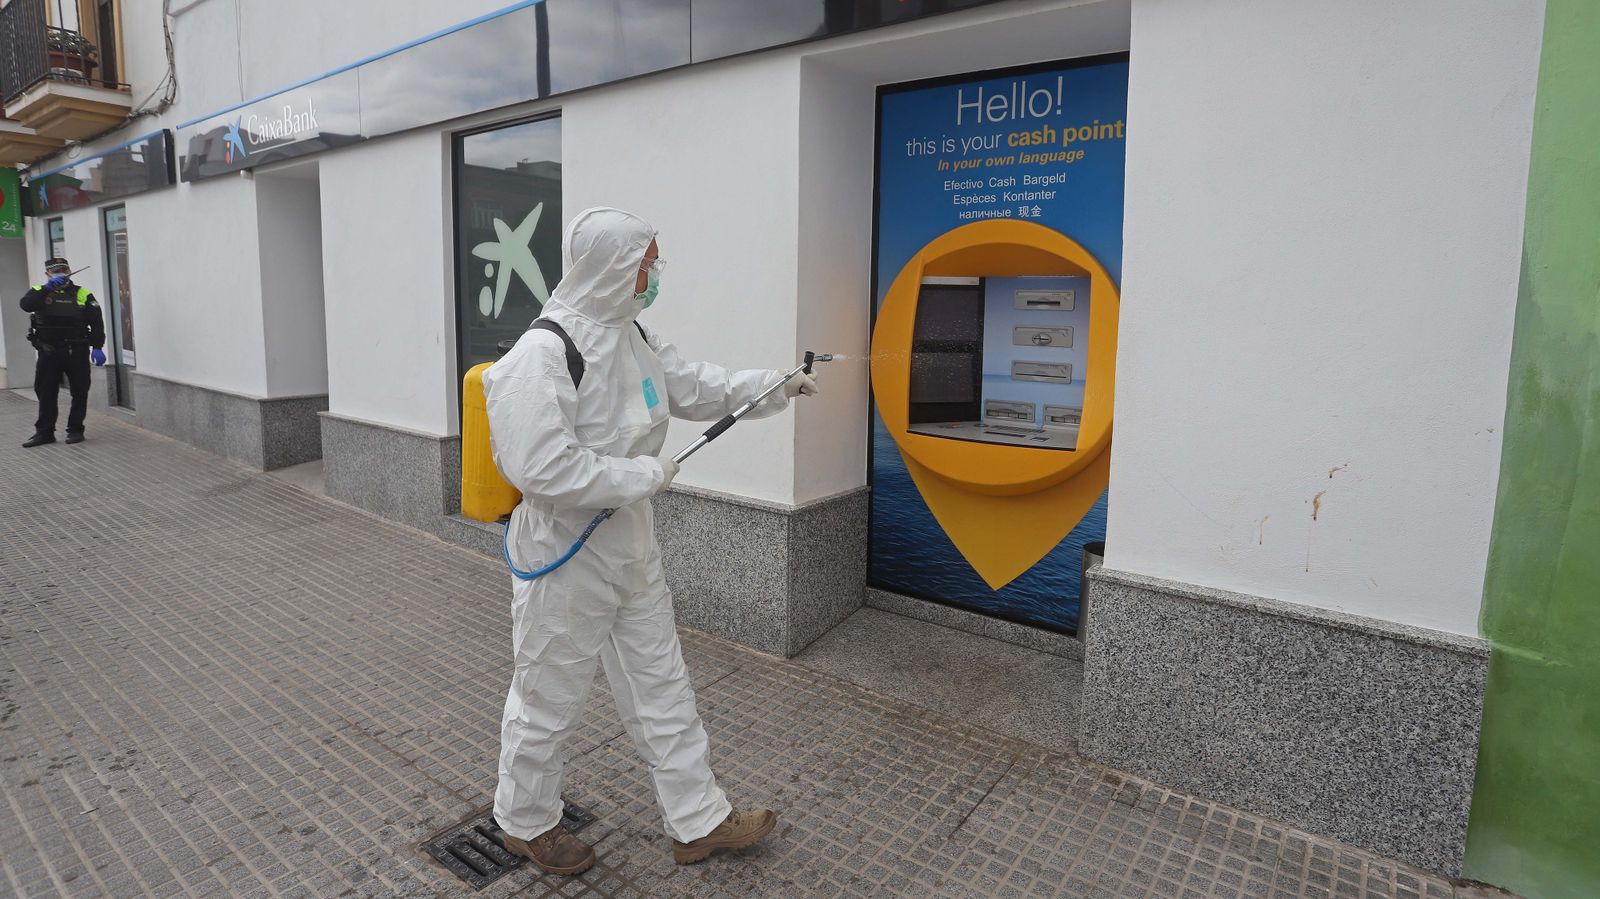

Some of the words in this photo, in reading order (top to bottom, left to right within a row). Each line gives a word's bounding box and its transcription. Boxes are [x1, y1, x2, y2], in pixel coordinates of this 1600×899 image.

[957, 76, 1063, 125] Hello!
[247, 96, 319, 146] CaixaBank
[906, 137, 936, 157] this
[942, 134, 956, 153] is
[960, 132, 1003, 156] your
[1007, 125, 1056, 147] cash
[1062, 119, 1124, 148] point
[937, 159, 950, 172] In
[952, 159, 982, 172] your
[985, 155, 1015, 168] own
[1018, 149, 1085, 165] language
[944, 178, 984, 191] Efectivo
[988, 175, 1016, 188] Cash
[1023, 173, 1066, 187] Bargeld
[953, 193, 997, 207] Espèces
[1003, 189, 1057, 202] Kontanter
[959, 208, 1011, 220] наличные
[1017, 205, 1042, 218] 现金
